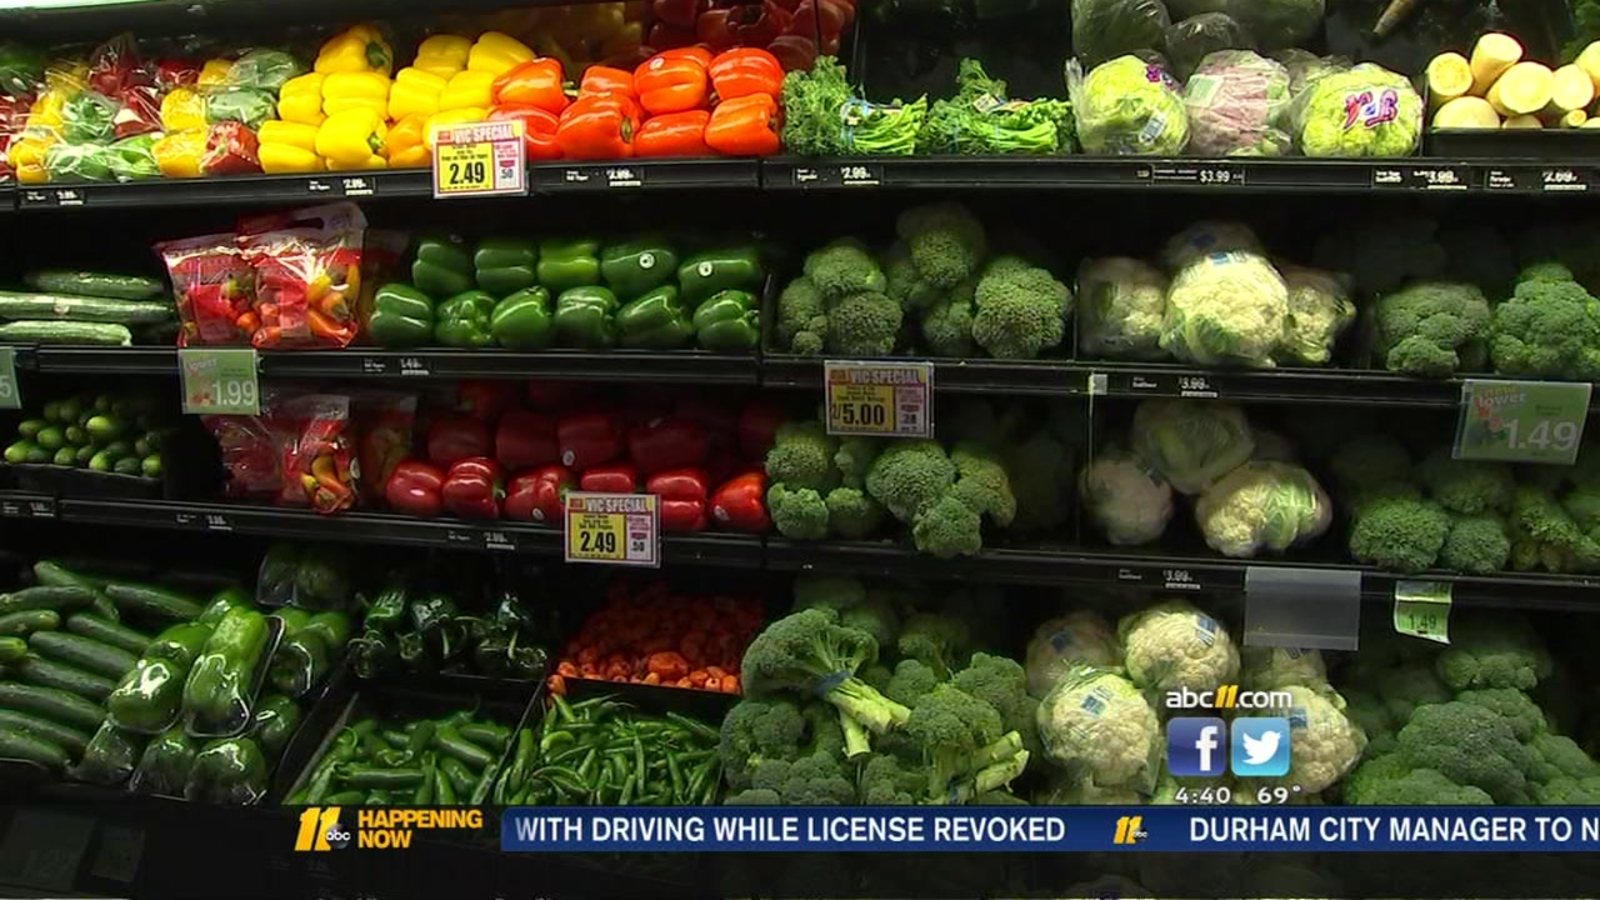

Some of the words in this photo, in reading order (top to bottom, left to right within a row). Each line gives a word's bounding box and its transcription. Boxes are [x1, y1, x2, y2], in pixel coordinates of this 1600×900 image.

[473, 123, 514, 142] SPECIAL
[449, 161, 485, 184] 2.49
[851, 369, 871, 384] VIC
[872, 369, 920, 385] SPECIAL
[212, 379, 257, 406] 1.99
[1502, 418, 1578, 451] 1.49
[585, 498, 602, 512] VIC
[604, 498, 646, 513] SPECIAL
[580, 530, 616, 553] 2.49
